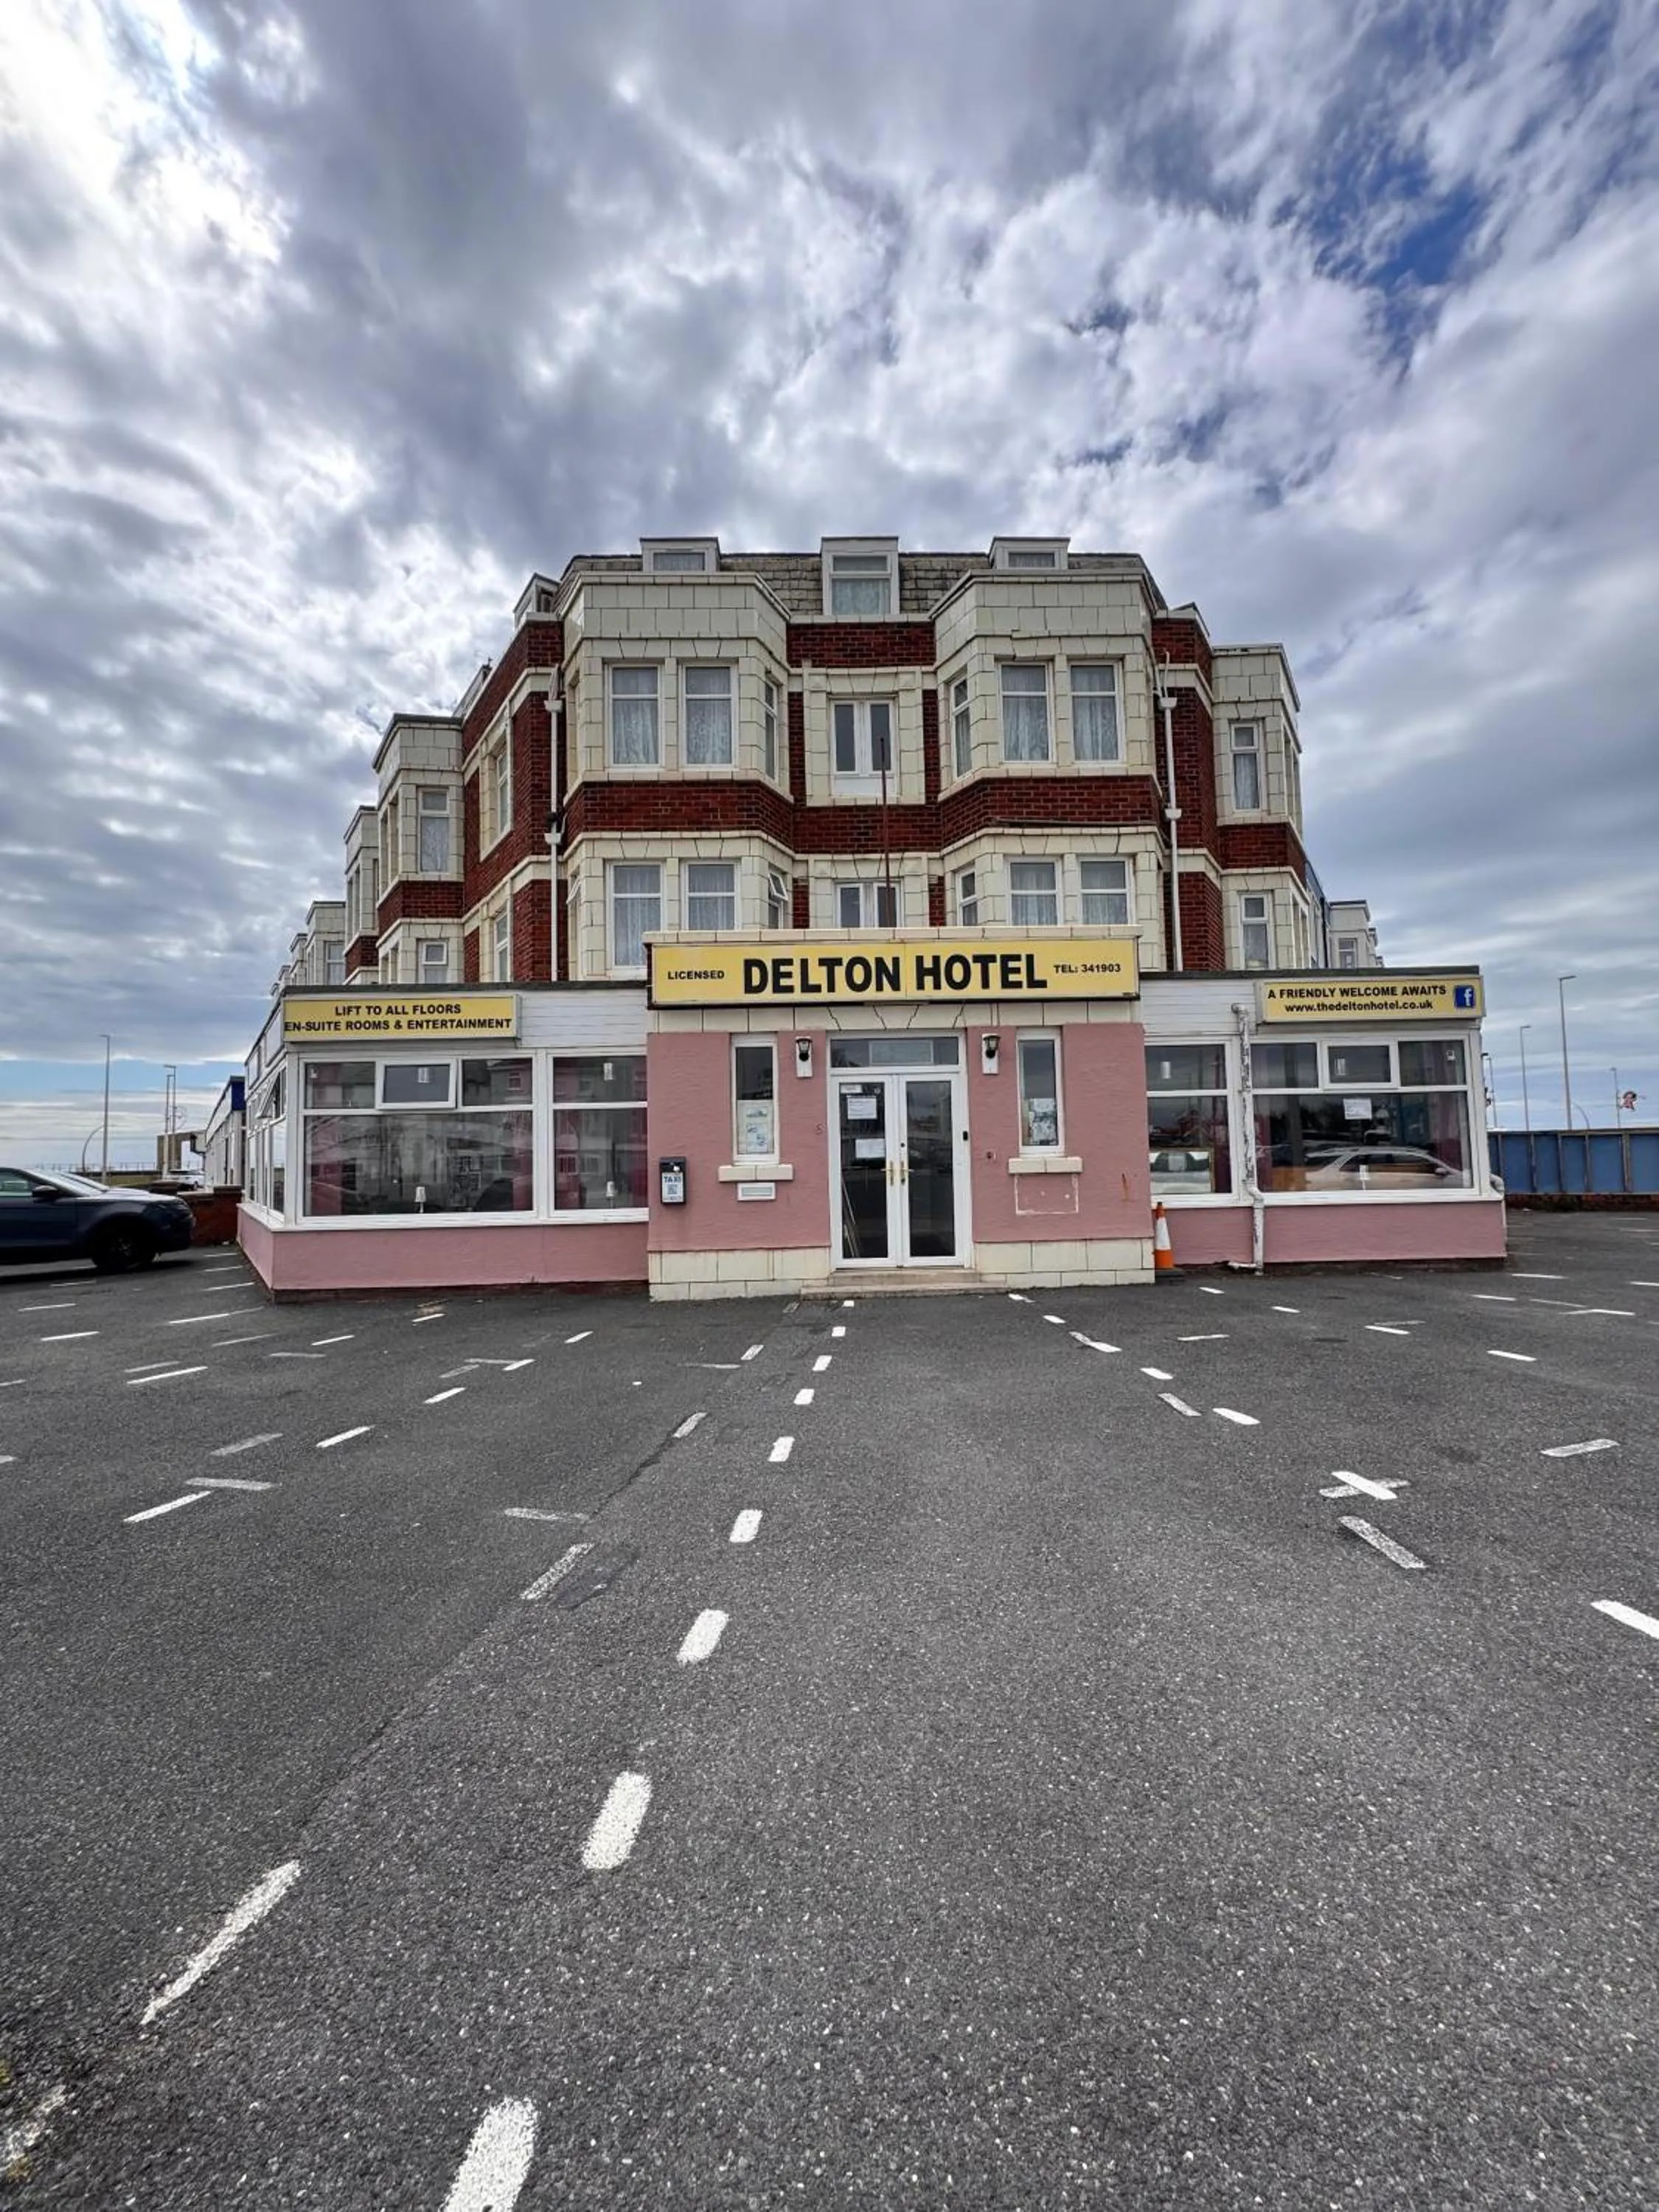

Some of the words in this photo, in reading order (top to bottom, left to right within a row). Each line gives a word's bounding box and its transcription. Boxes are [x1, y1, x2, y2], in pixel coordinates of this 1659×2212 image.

[667, 970, 725, 980] LICENSED
[743, 956, 901, 995] DELTON
[915, 953, 1048, 990] HOTEL
[1053, 964, 1078, 974] TEL:
[1081, 963, 1121, 973] 341903
[1267, 989, 1276, 999] A
[1279, 987, 1336, 998] FRIENDLY
[1339, 986, 1398, 997] WELCOME
[1402, 985, 1447, 996] AWAITS
[335, 1005, 361, 1016] LIFT
[366, 1005, 382, 1015] TO
[386, 1005, 409, 1015] ALL
[412, 1004, 462, 1015] FLOORS
[1285, 999, 1433, 1012] www.thedeltonhotel.co.uk
[285, 1020, 341, 1032] EN-SUITE
[346, 1020, 390, 1030] ROOMS
[394, 1019, 403, 1029] &
[407, 1018, 512, 1029] ENTERTAINMENT
